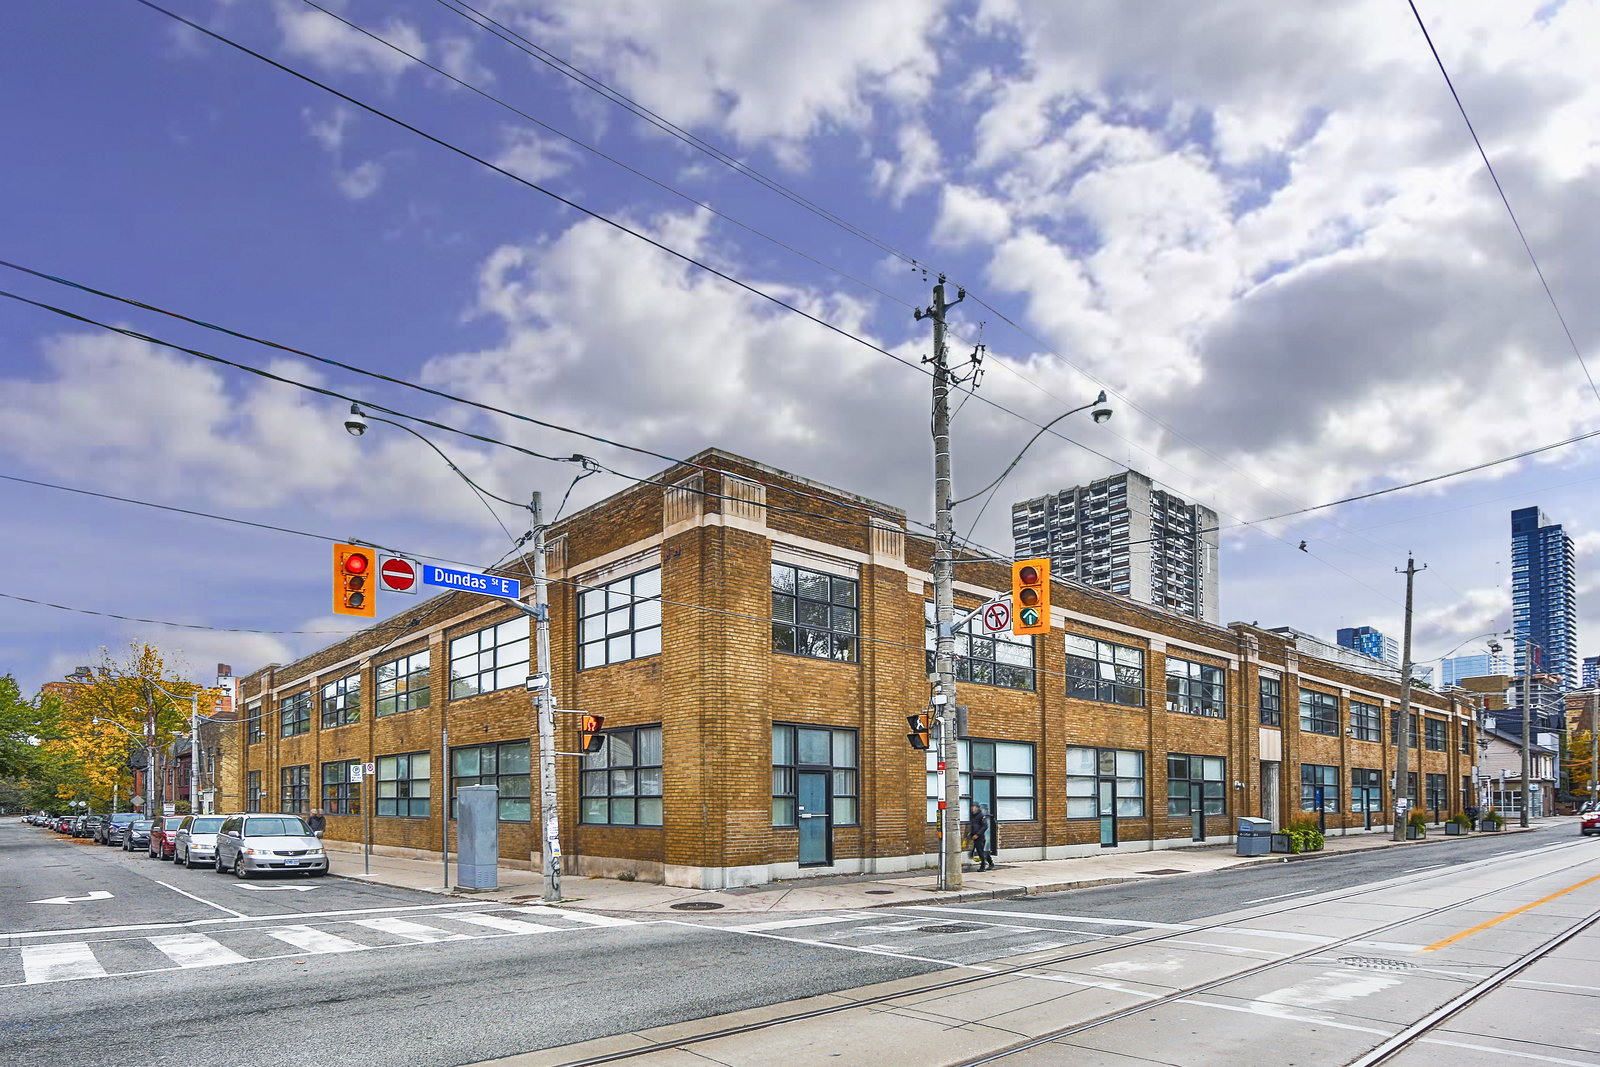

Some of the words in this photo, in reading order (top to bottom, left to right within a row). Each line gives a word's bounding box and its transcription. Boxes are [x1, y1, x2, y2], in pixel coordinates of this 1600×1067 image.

[434, 568, 487, 590] Dundas
[491, 578, 499, 586] St
[501, 580, 510, 593] E
